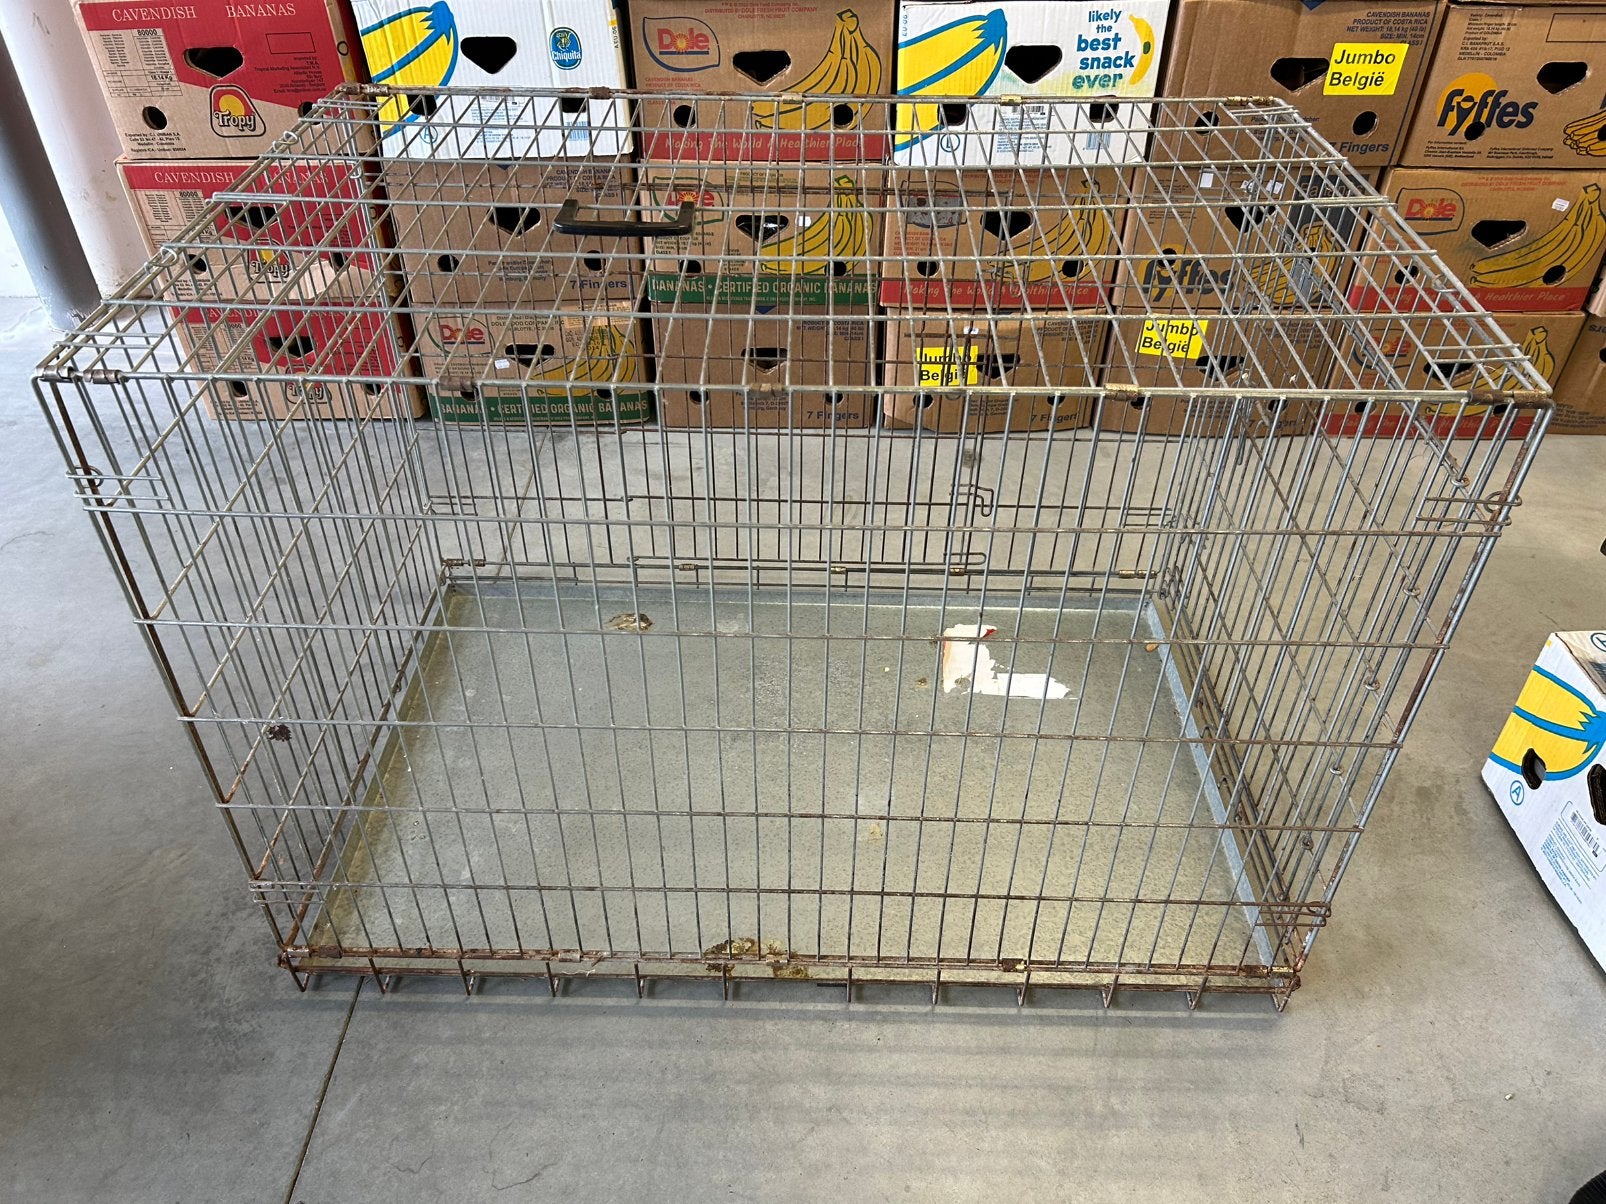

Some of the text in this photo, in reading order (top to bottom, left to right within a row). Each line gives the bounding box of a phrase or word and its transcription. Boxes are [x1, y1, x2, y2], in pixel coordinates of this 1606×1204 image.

[112, 3, 296, 22] CAVENDISH BANANAS
[1088, 8, 1122, 23] likely
[1096, 24, 1113, 33] the
[657, 28, 710, 50] Dole
[1076, 33, 1122, 51] best
[551, 50, 582, 62] Chiquita
[1079, 51, 1135, 70] snack
[1334, 50, 1396, 65] Jumbo
[1072, 72, 1123, 90] ever
[1329, 71, 1385, 91] België
[1437, 88, 1539, 136] fyffes
[213, 111, 256, 131] Tropy
[779, 138, 830, 148] Heathier
[1339, 142, 1390, 154] Fingers
[154, 171, 235, 184] CAVENDISH
[1405, 198, 1457, 217] Dole
[250, 260, 290, 278] Topy
[570, 280, 627, 291] 7 Finers
[717, 281, 769, 293] CERTIFED
[1486, 291, 1537, 301] Healthier
[1537, 291, 1566, 301] Place
[1142, 336, 1189, 354] Begië
[920, 369, 968, 383] Begi
[499, 403, 548, 414] CERTIED
[600, 400, 648, 412] BAANAS
[807, 411, 813, 420] 7
[1040, 412, 1080, 424] Figers
[1511, 784, 1523, 803] A
